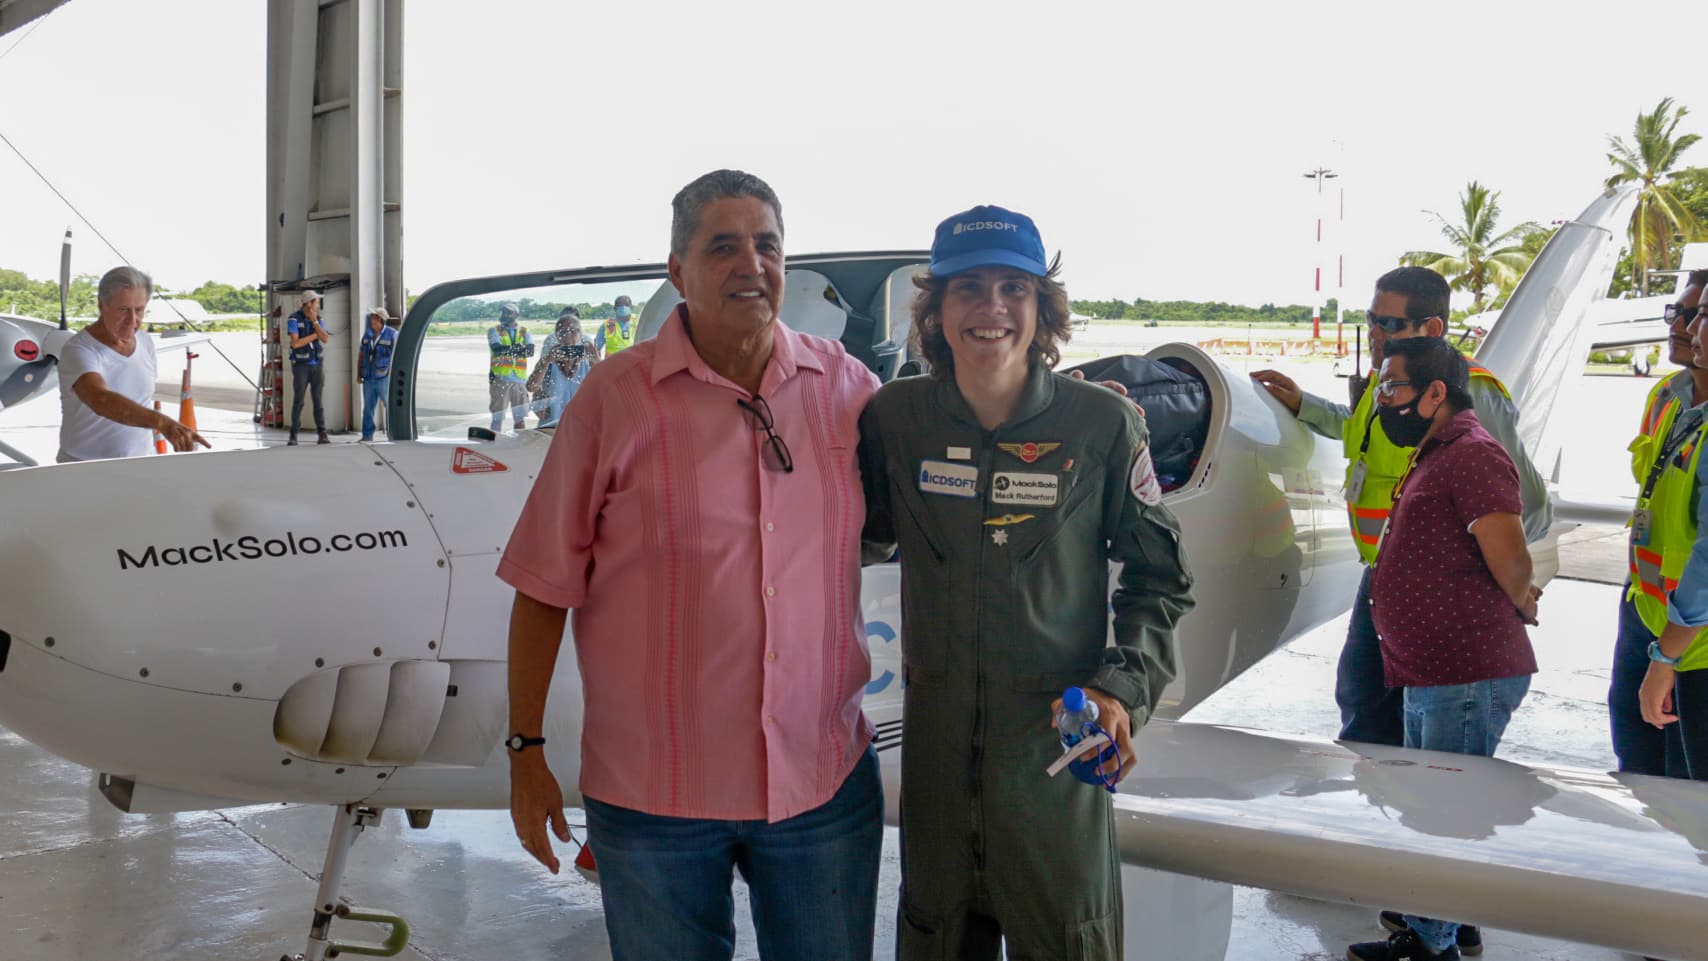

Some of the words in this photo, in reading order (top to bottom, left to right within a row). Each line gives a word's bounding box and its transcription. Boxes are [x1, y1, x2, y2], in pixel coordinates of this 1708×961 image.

[963, 222, 1018, 232] ICDSOFT
[929, 474, 976, 489] ICDSOFT
[117, 529, 408, 570] MackSolo.com
